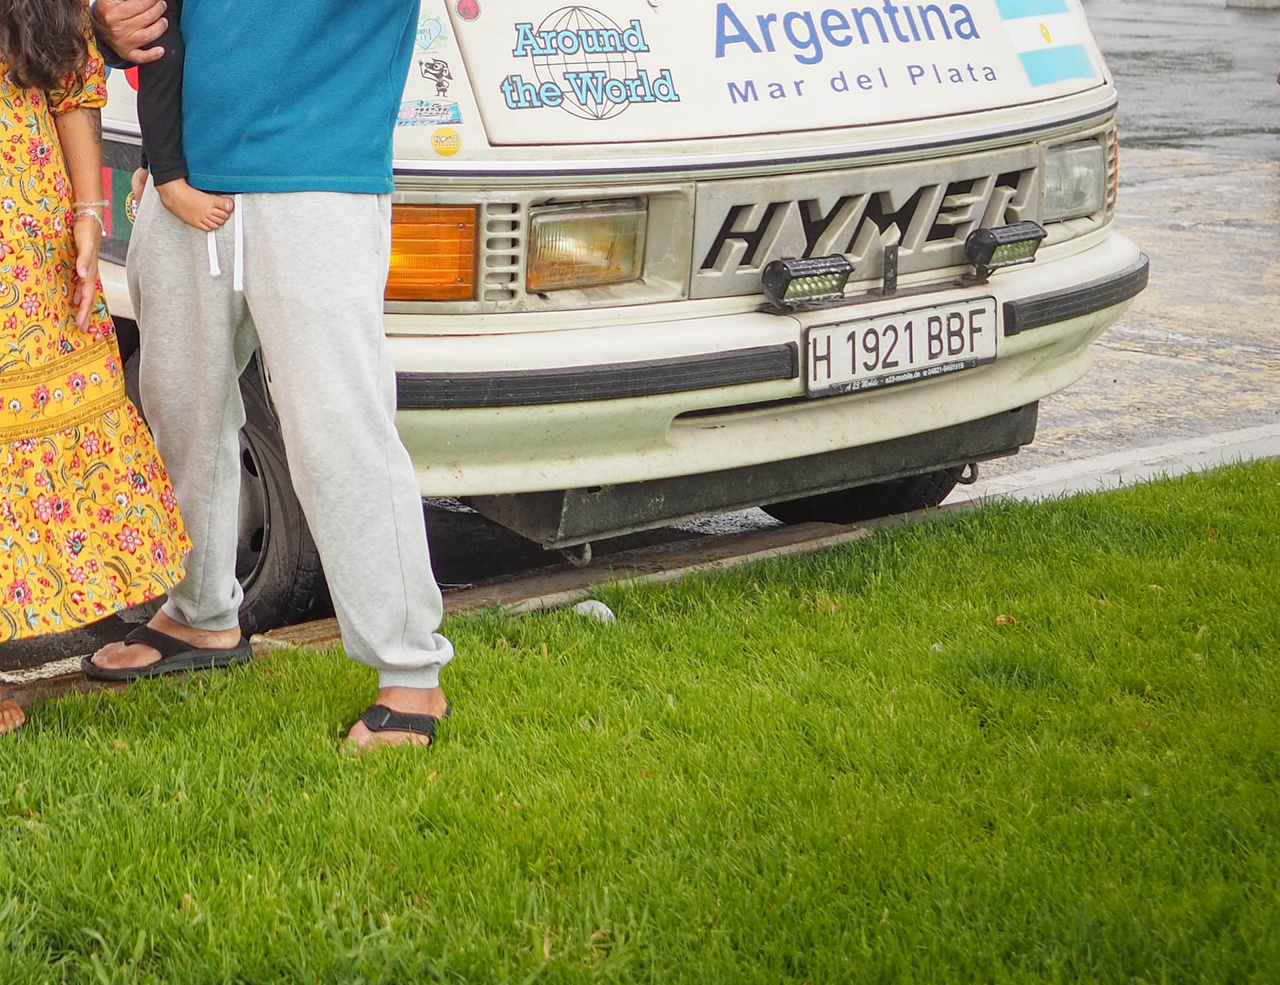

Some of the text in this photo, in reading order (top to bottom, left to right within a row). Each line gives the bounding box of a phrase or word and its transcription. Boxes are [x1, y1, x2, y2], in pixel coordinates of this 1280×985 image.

[512, 19, 651, 58] Around
[500, 69, 681, 110] the World
[726, 62, 998, 105] Mar del Plata
[700, 165, 1038, 271] HYMER
[811, 307, 987, 382] H 1921 BBF
